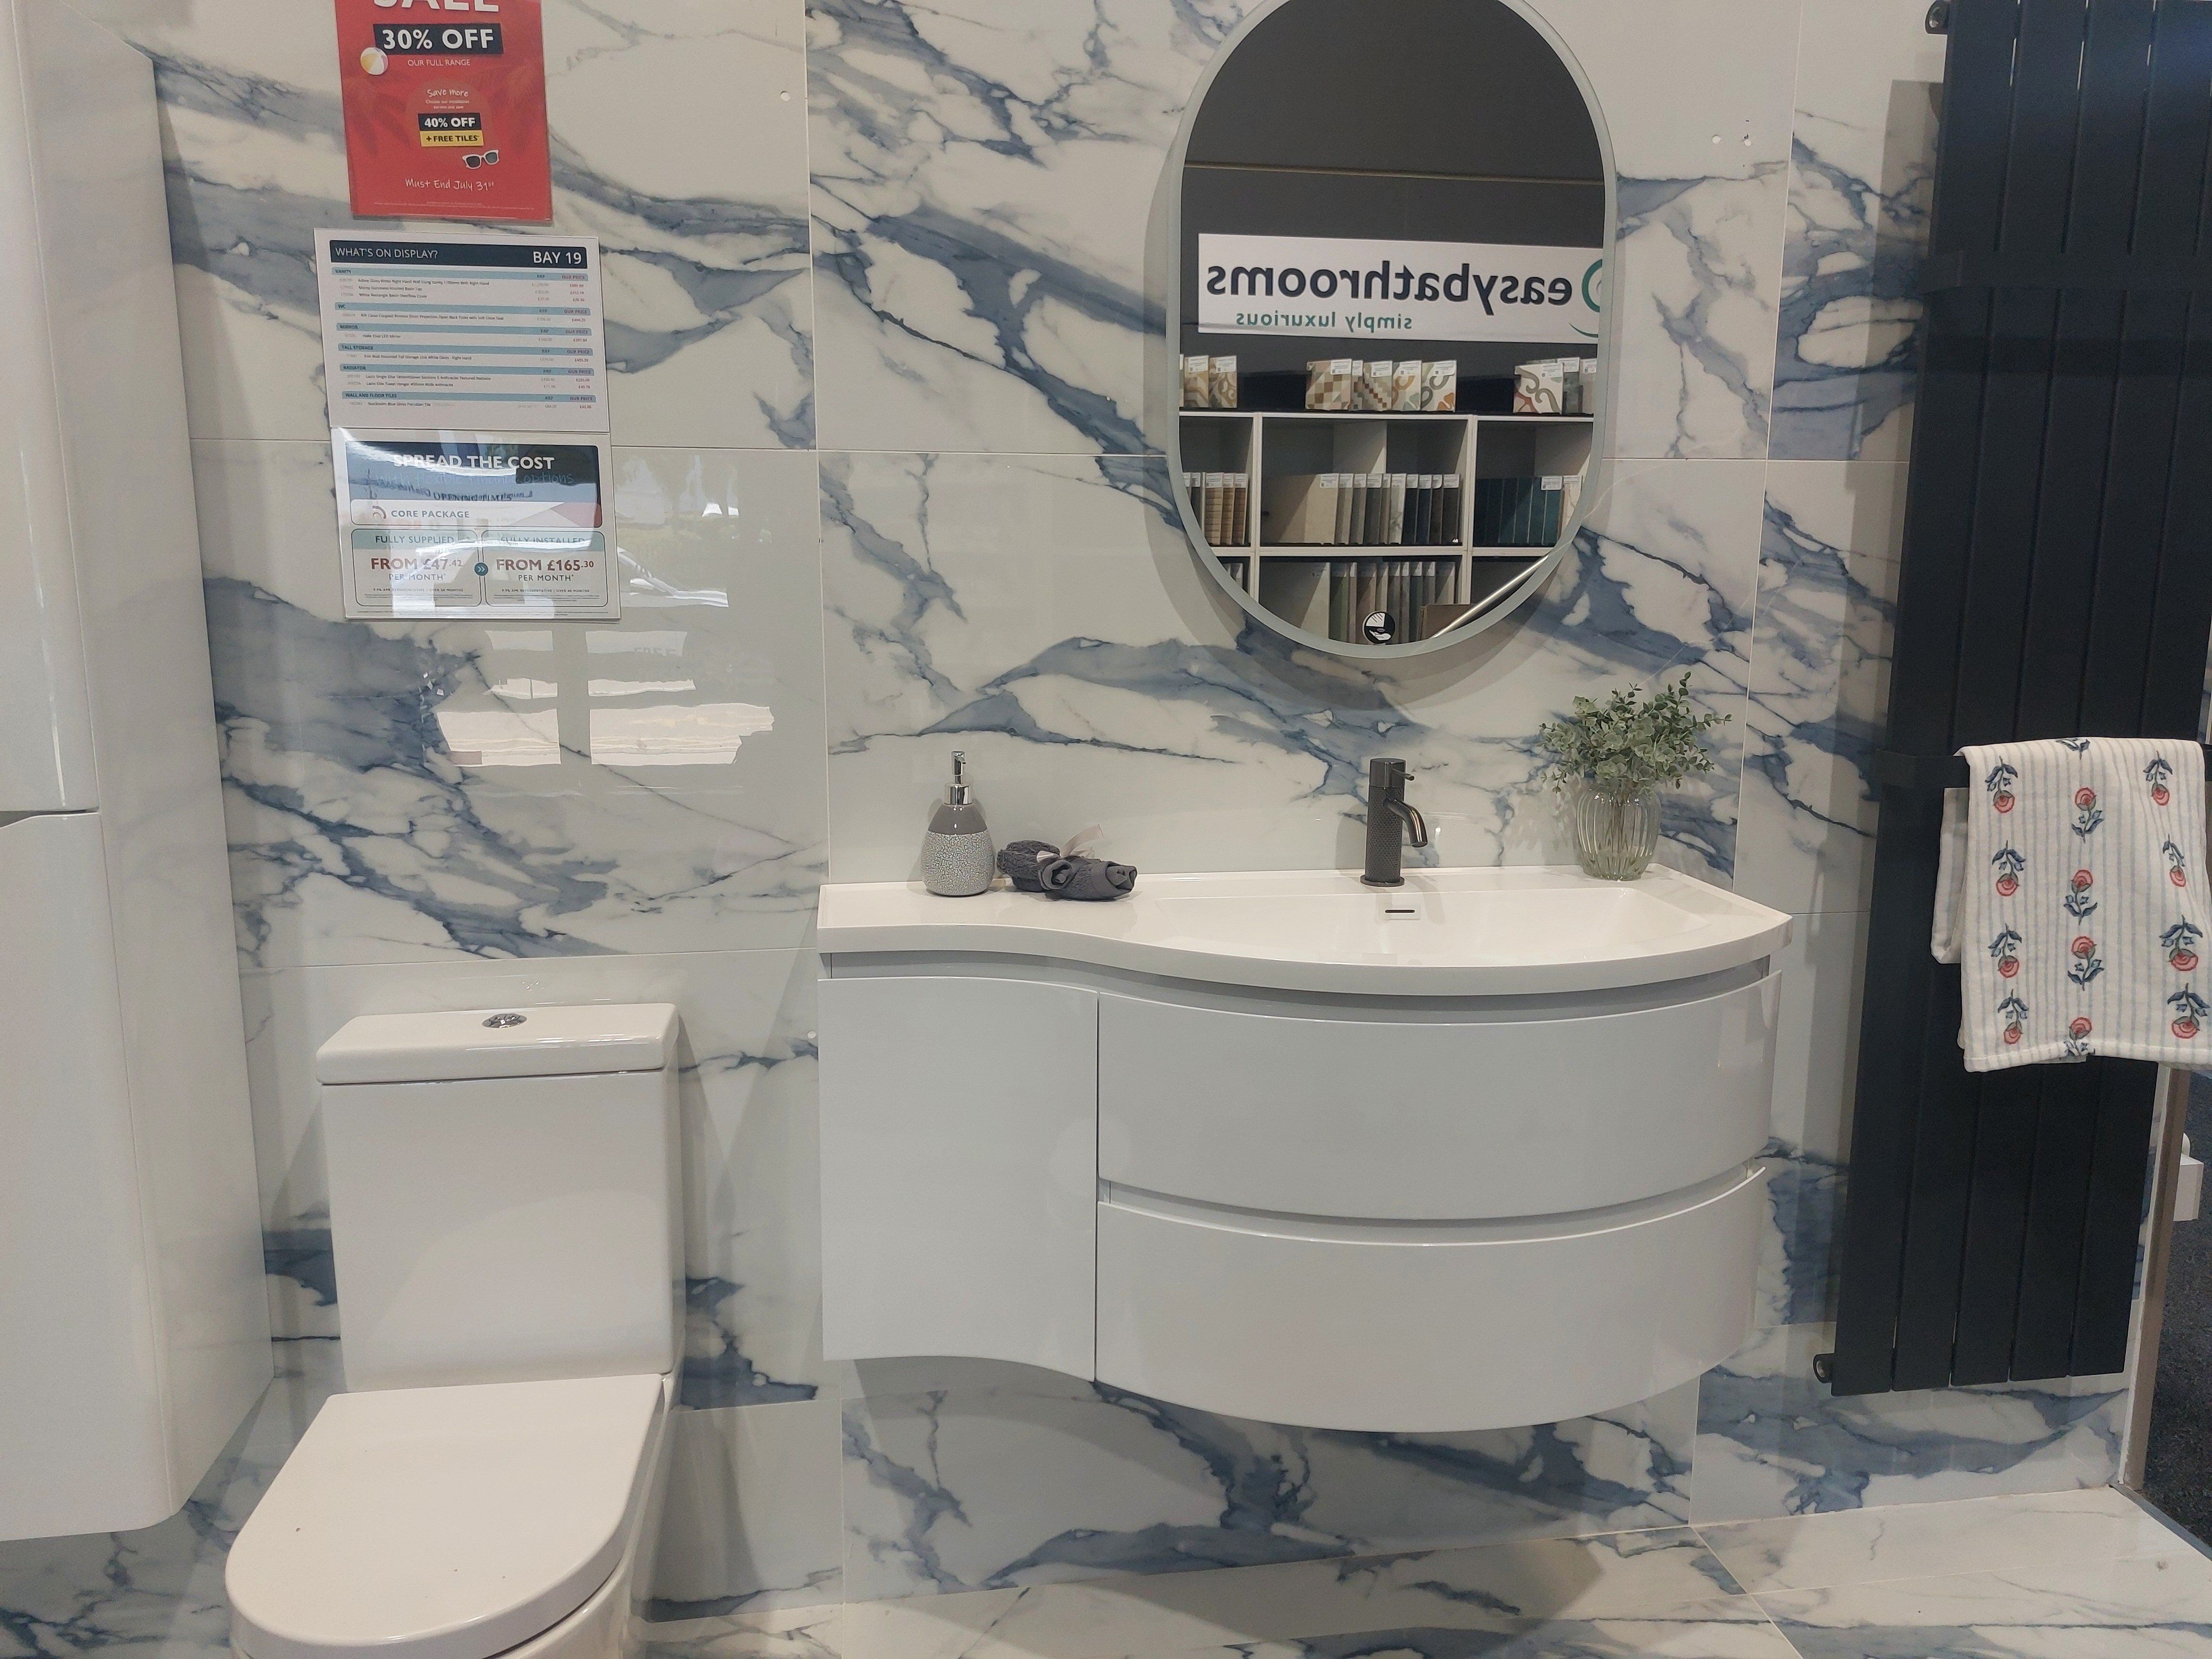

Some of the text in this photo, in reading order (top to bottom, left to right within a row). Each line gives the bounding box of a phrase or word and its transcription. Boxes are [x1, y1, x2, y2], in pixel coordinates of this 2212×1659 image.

[382, 29, 494, 49] 30% OFF
[427, 88, 469, 98] Save more
[424, 117, 476, 128] 40% OFF
[405, 178, 431, 188] Must
[433, 179, 451, 189] End
[453, 180, 473, 192] July
[335, 247, 439, 259] WHAT'S ON DISPLAY?
[532, 251, 582, 265] BAY 19
[394, 454, 555, 470] SPREAD THE COST
[524, 471, 575, 485] options
[422, 510, 470, 519] PACKAGE
[376, 535, 454, 544] FULLY SUPPLIED
[371, 558, 463, 570] FROM £47.42
[496, 559, 594, 571] FROM £165.30
